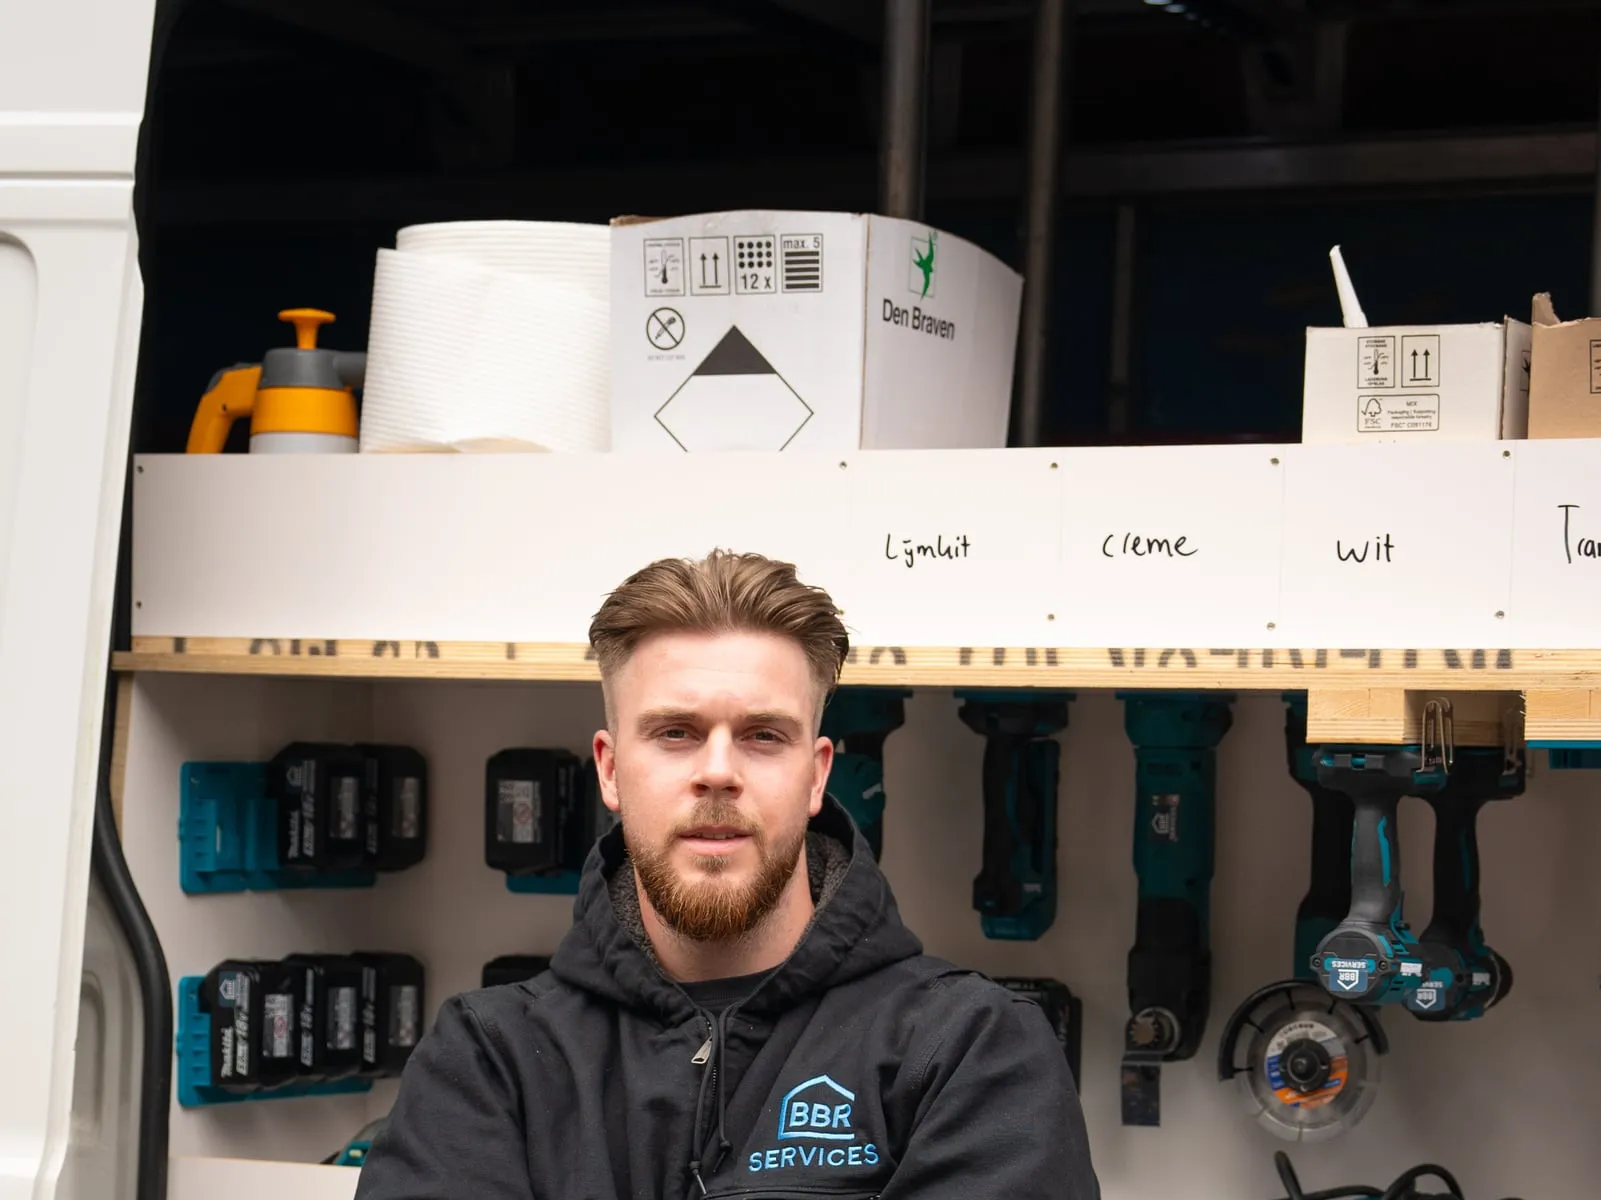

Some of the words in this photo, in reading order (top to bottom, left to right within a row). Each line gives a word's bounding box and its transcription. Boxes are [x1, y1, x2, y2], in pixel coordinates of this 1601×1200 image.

[783, 238, 809, 249] max.
[813, 236, 821, 249] 5
[740, 273, 759, 290] 12
[764, 276, 772, 290] x
[883, 298, 909, 327] Den
[912, 305, 955, 341] Braven
[1332, 960, 1367, 968] SERVICES
[789, 1101, 852, 1128] BBR
[749, 1143, 879, 1172] SERVICES
